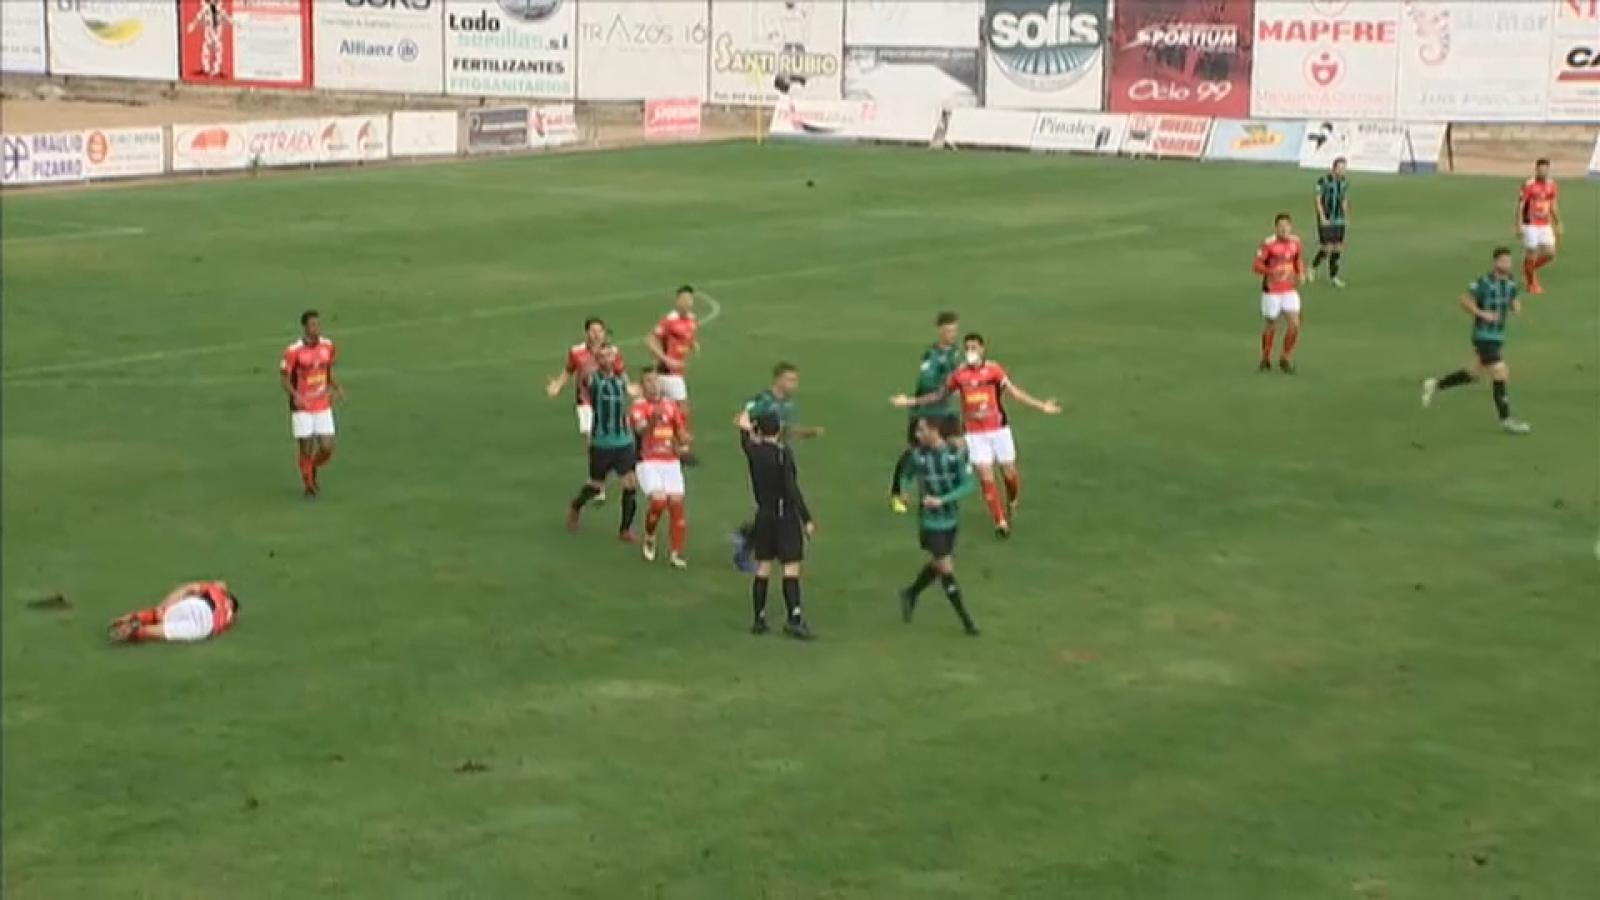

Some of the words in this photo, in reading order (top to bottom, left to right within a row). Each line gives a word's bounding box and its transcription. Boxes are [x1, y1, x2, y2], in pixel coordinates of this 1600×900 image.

[991, 3, 1100, 48] solis
[1258, 20, 1396, 44] MAPFRE
[338, 39, 394, 57] Allianz
[452, 58, 565, 75] FERTILIZANTES
[1197, 80, 1233, 102] 99
